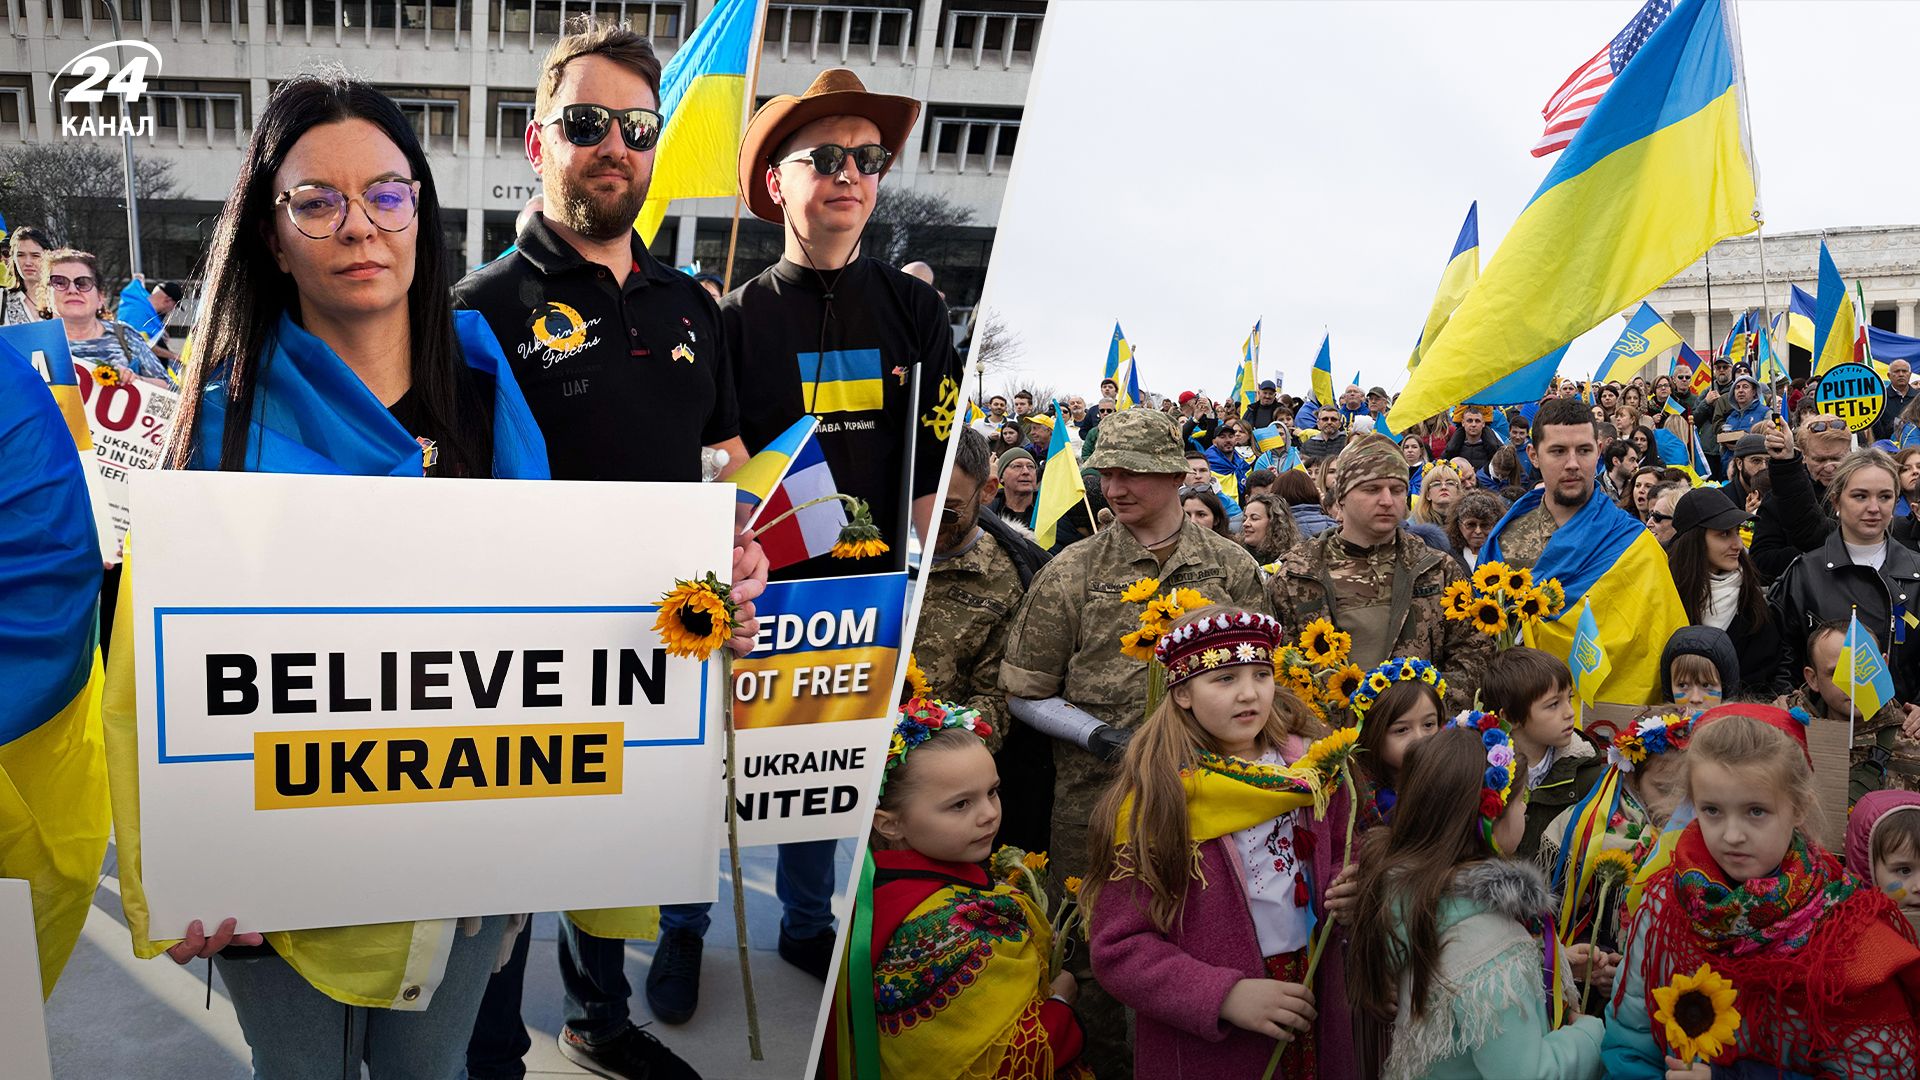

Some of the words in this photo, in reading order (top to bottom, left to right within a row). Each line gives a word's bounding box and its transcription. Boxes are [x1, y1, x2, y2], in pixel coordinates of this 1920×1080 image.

[492, 185, 535, 199] CITY
[518, 317, 602, 360] Ukrainian
[542, 336, 600, 369] Falcons
[1832, 367, 1863, 377] ПУТІН
[562, 379, 590, 397] UAF
[1822, 376, 1876, 400] PUTIN
[1824, 398, 1877, 418] ГЕТЬ!
[1850, 417, 1872, 430] OUT!
[110, 449, 126, 463] IN
[205, 650, 565, 716] BELIEVE
[592, 648, 667, 706] IN
[791, 662, 872, 698] FREE
[275, 733, 608, 797] UKRAINE
[743, 737, 867, 779] UKRAINE
